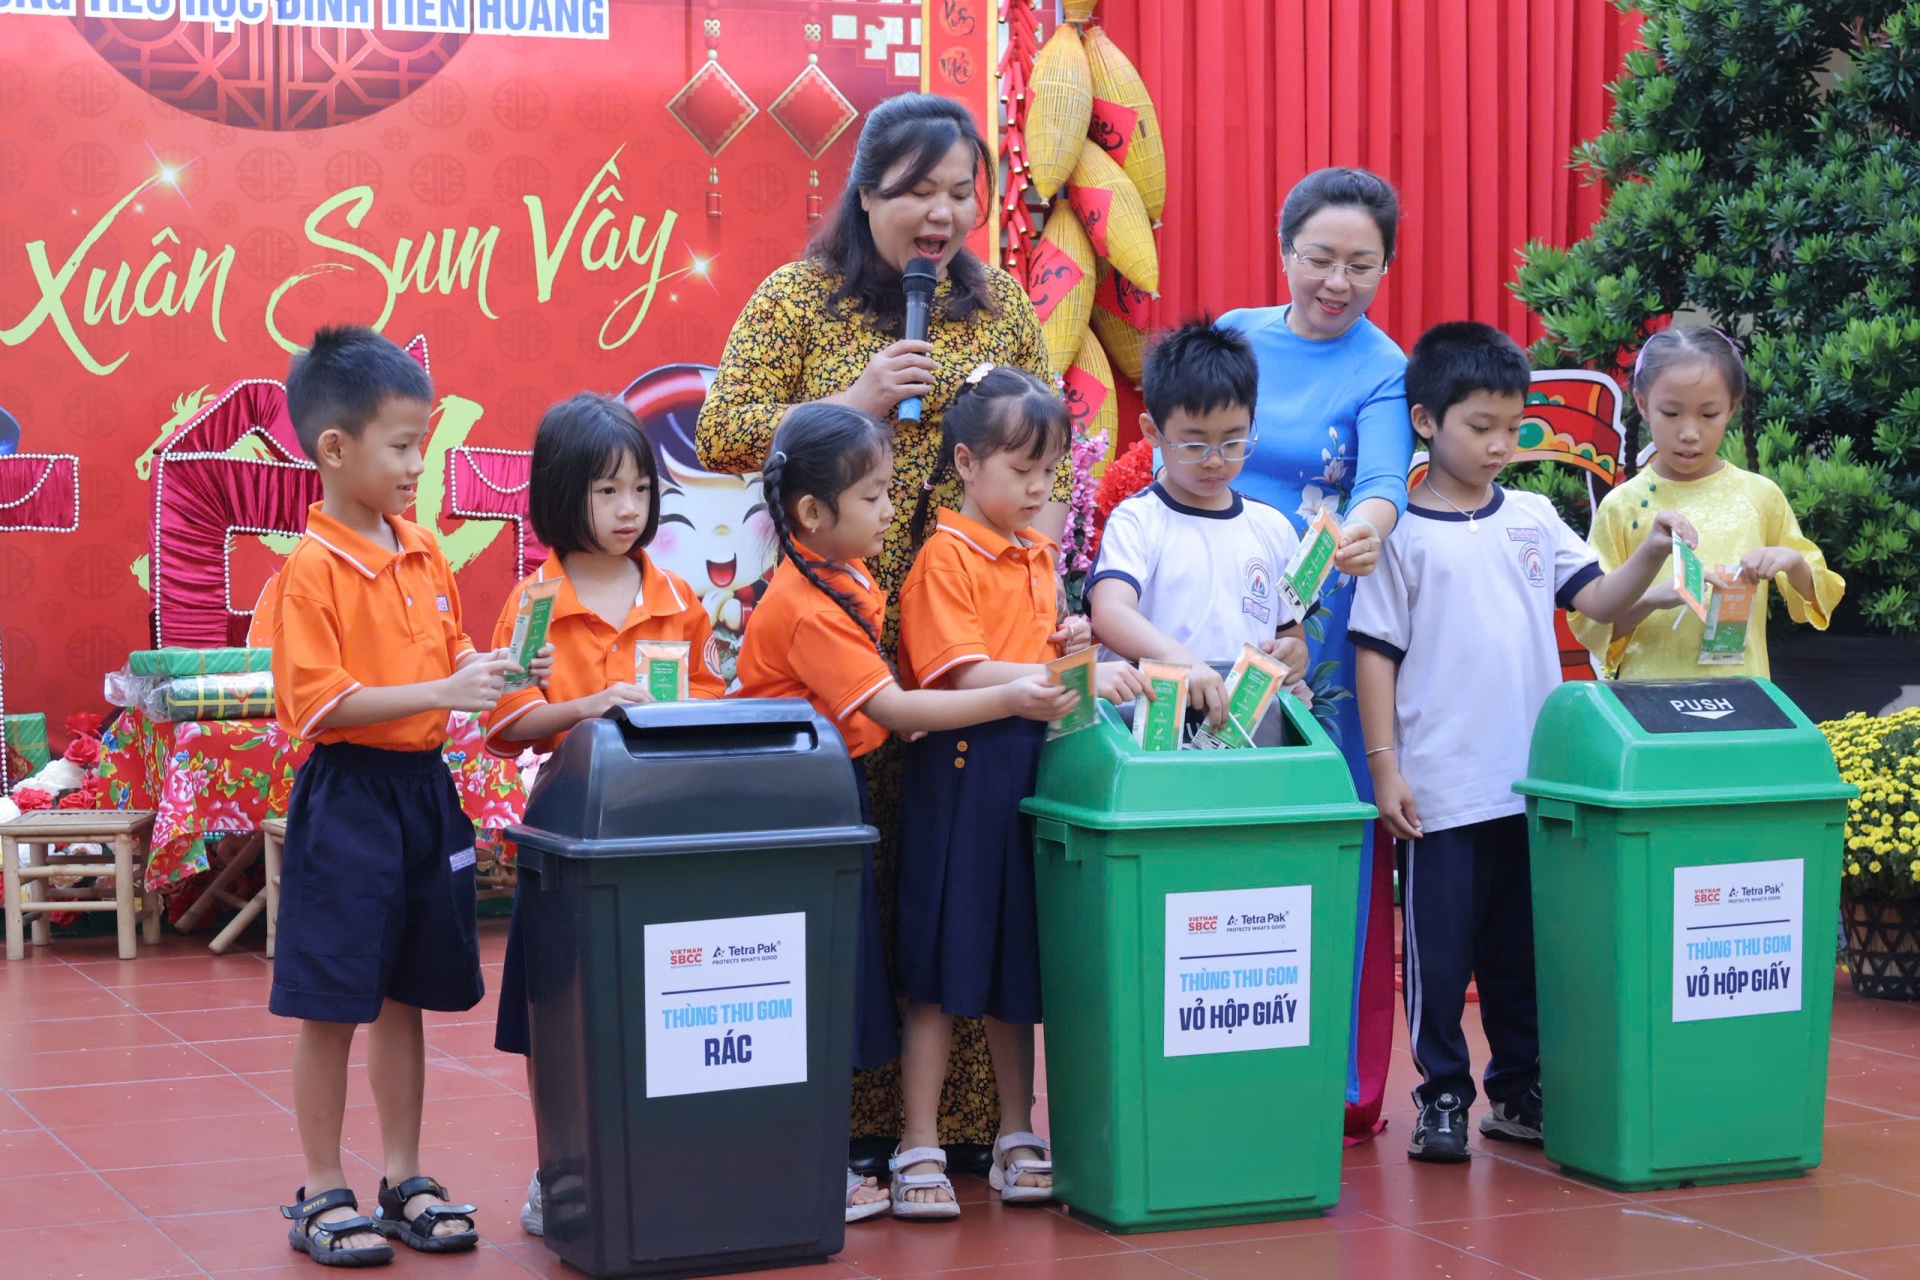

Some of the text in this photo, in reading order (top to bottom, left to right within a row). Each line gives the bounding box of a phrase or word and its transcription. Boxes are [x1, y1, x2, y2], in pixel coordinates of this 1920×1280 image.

[0, 173, 236, 376] Xuân
[265, 185, 500, 355] Sum
[1669, 698, 1734, 711] PUSH
[1741, 886, 1763, 896] Tetra
[1694, 893, 1720, 903] SBCC
[1188, 921, 1217, 931] SBCC
[1241, 914, 1266, 925] Tetra
[670, 947, 703, 955] VIETNAM
[728, 944, 756, 956] Tetra
[1686, 934, 1792, 961] THÙNG THU GOM
[670, 954, 702, 965] SBCC
[1179, 966, 1298, 992] THÙNG THU GOM
[1686, 960, 1791, 1000] VỎ HỘP GIẤY
[662, 998, 792, 1029] THÙNG THU GOM
[1179, 993, 1297, 1034] VỎ HỘP GIẤY
[704, 1029, 752, 1067] RÁC
